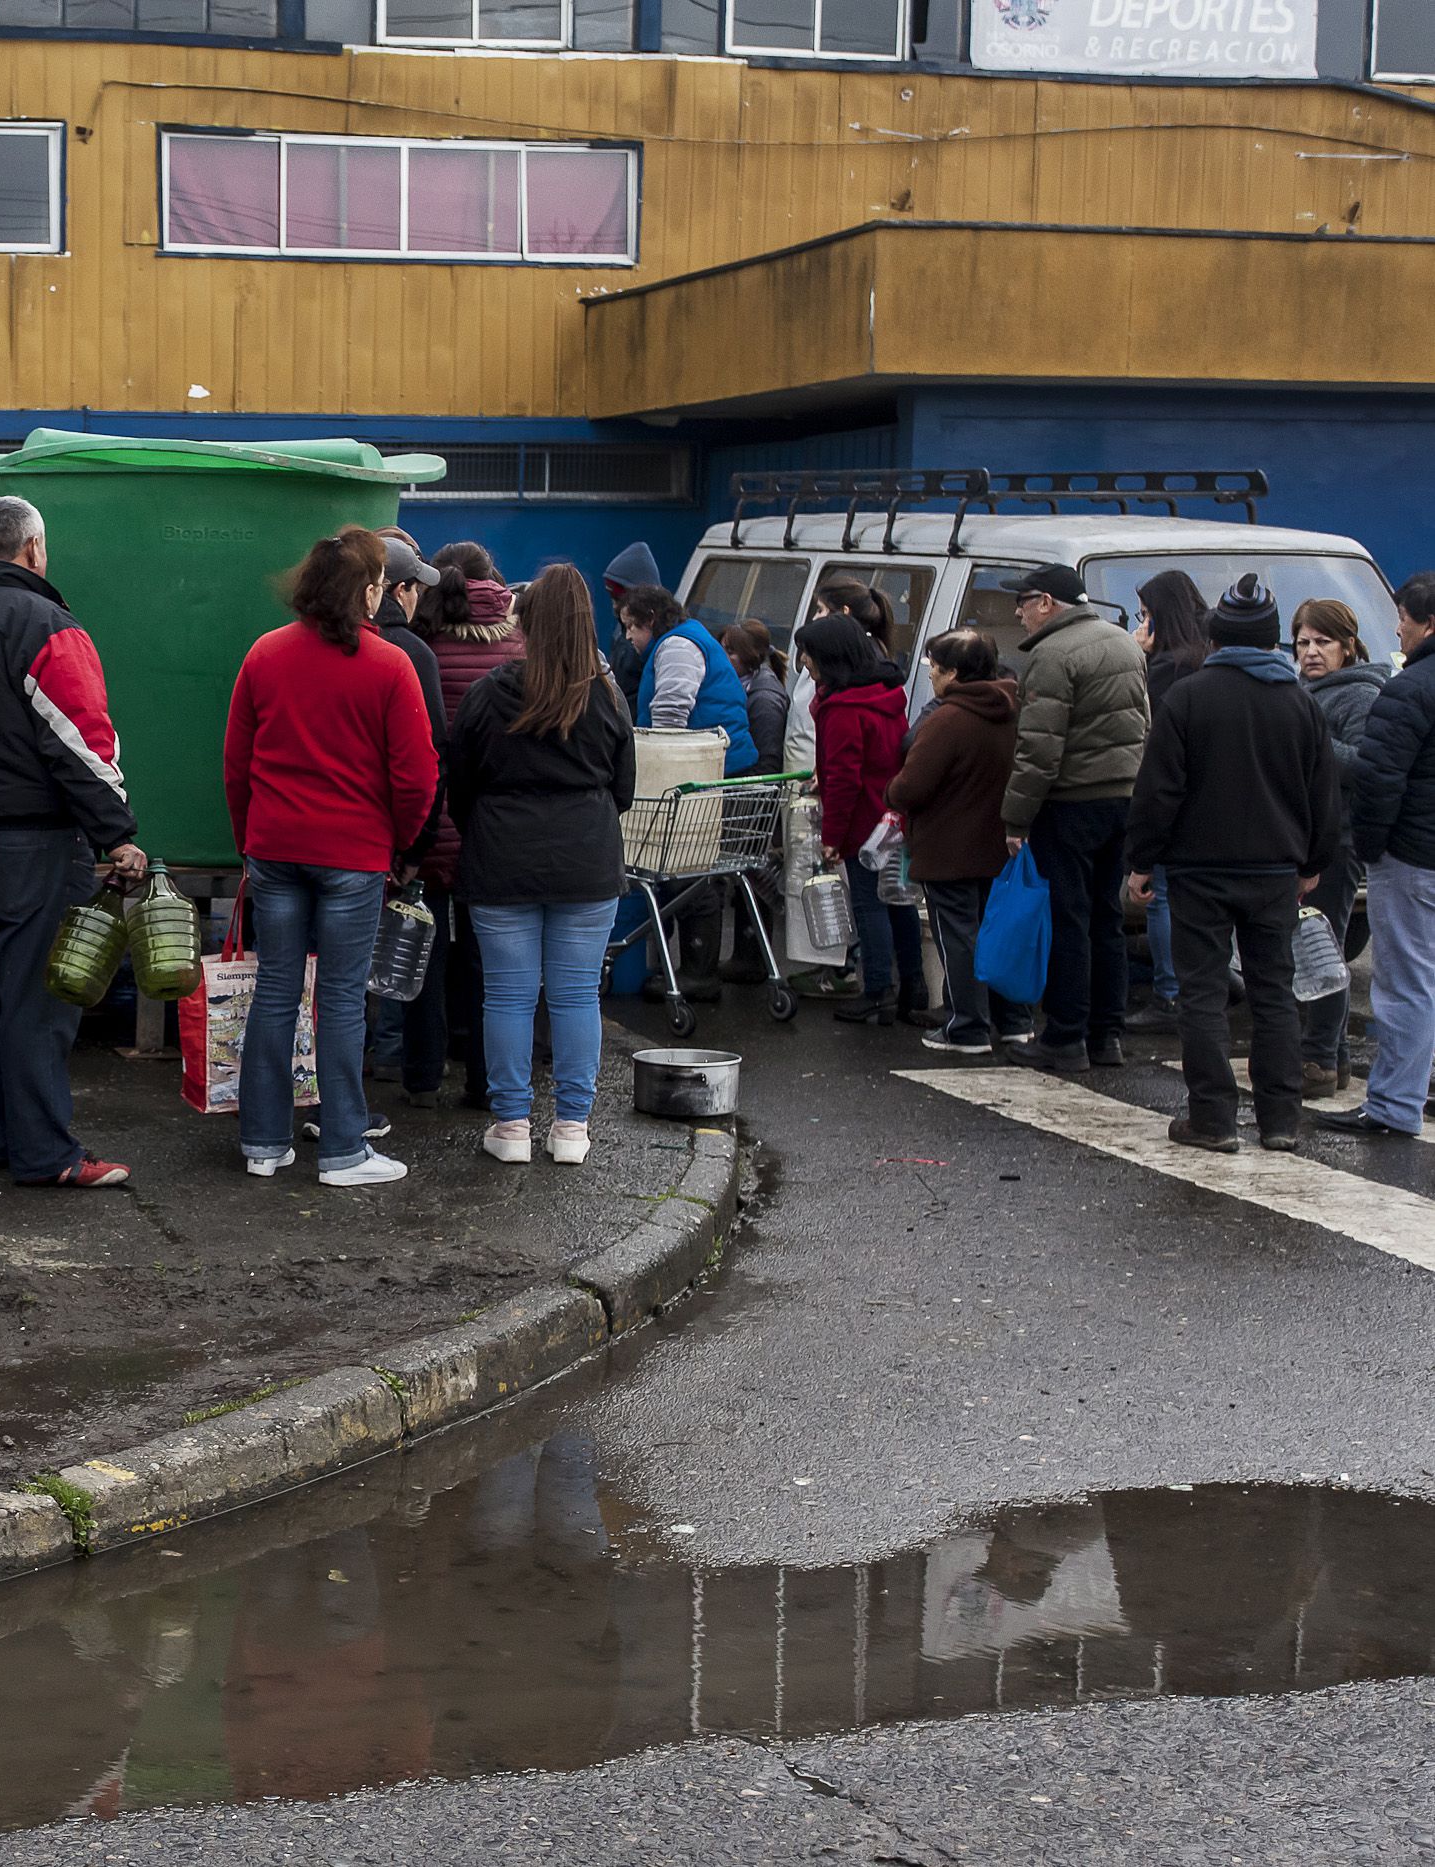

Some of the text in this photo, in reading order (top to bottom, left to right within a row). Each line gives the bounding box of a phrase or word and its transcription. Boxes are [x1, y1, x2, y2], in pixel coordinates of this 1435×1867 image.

[986, 42, 1059, 59] OSORNO
[1084, 36, 1101, 58] &
[1110, 37, 1298, 64] RECREACIÓN
[163, 525, 255, 541] Bioplastic
